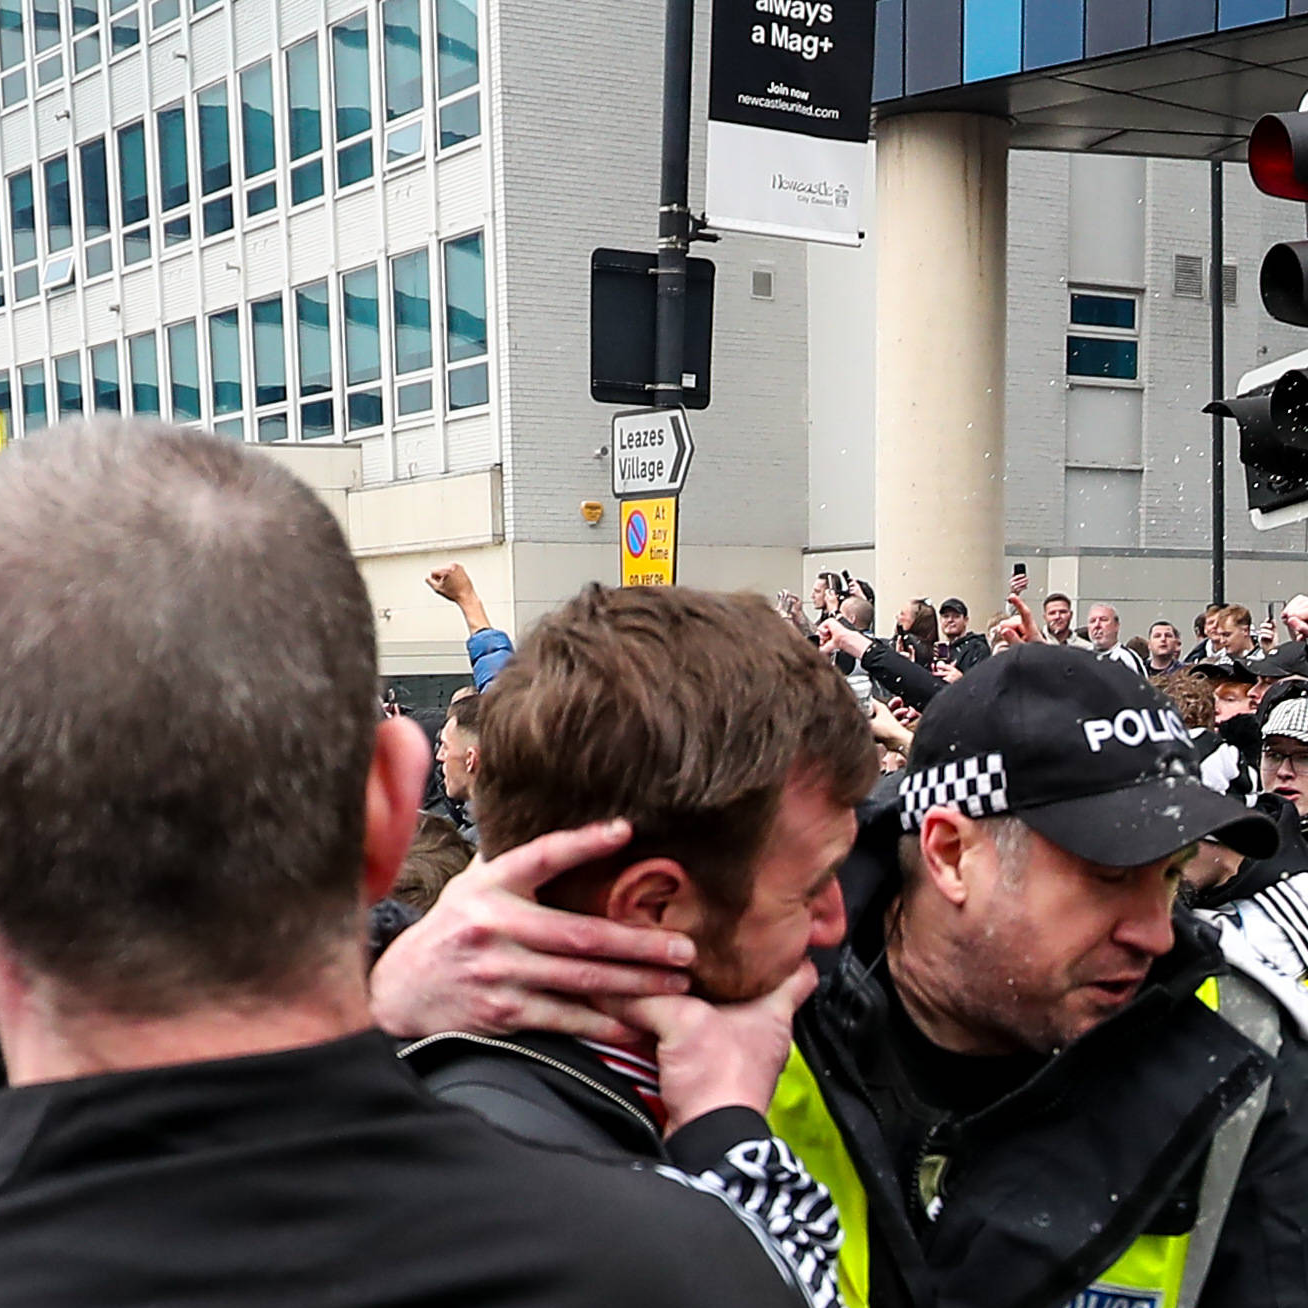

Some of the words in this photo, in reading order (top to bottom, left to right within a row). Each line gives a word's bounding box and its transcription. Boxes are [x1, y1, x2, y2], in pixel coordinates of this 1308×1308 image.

[751, 24, 766, 44] a
[771, 22, 834, 61] Mag+
[767, 81, 790, 97] Join
[790, 87, 810, 101] now
[738, 94, 840, 120] newcastleunited.com
[619, 427, 665, 450] Leazes
[618, 457, 664, 482] Village
[655, 505, 666, 521] At
[651, 529, 668, 543] any
[650, 545, 669, 561] time
